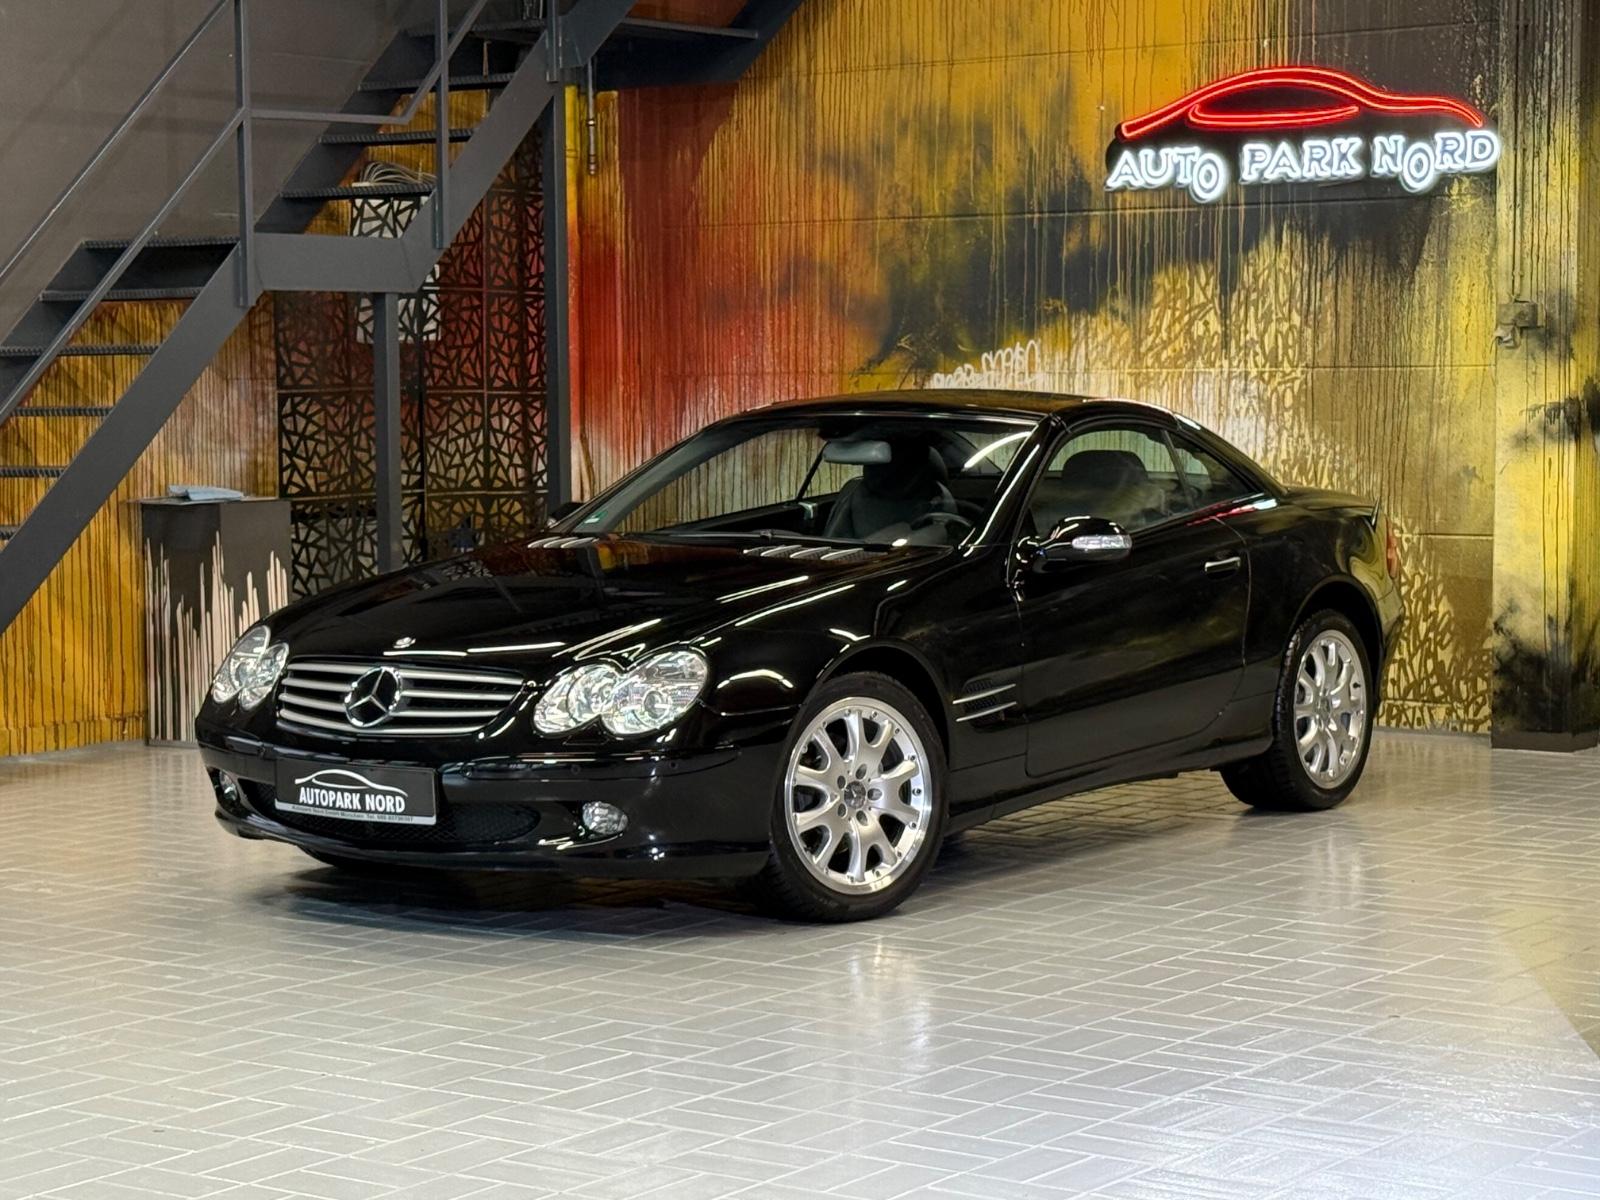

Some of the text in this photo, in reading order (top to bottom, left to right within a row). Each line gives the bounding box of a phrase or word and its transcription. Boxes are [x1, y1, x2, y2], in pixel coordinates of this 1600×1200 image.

[1105, 130, 1500, 201] AUTO PARK NORD
[299, 787, 405, 813] AUTOPARK NORD
